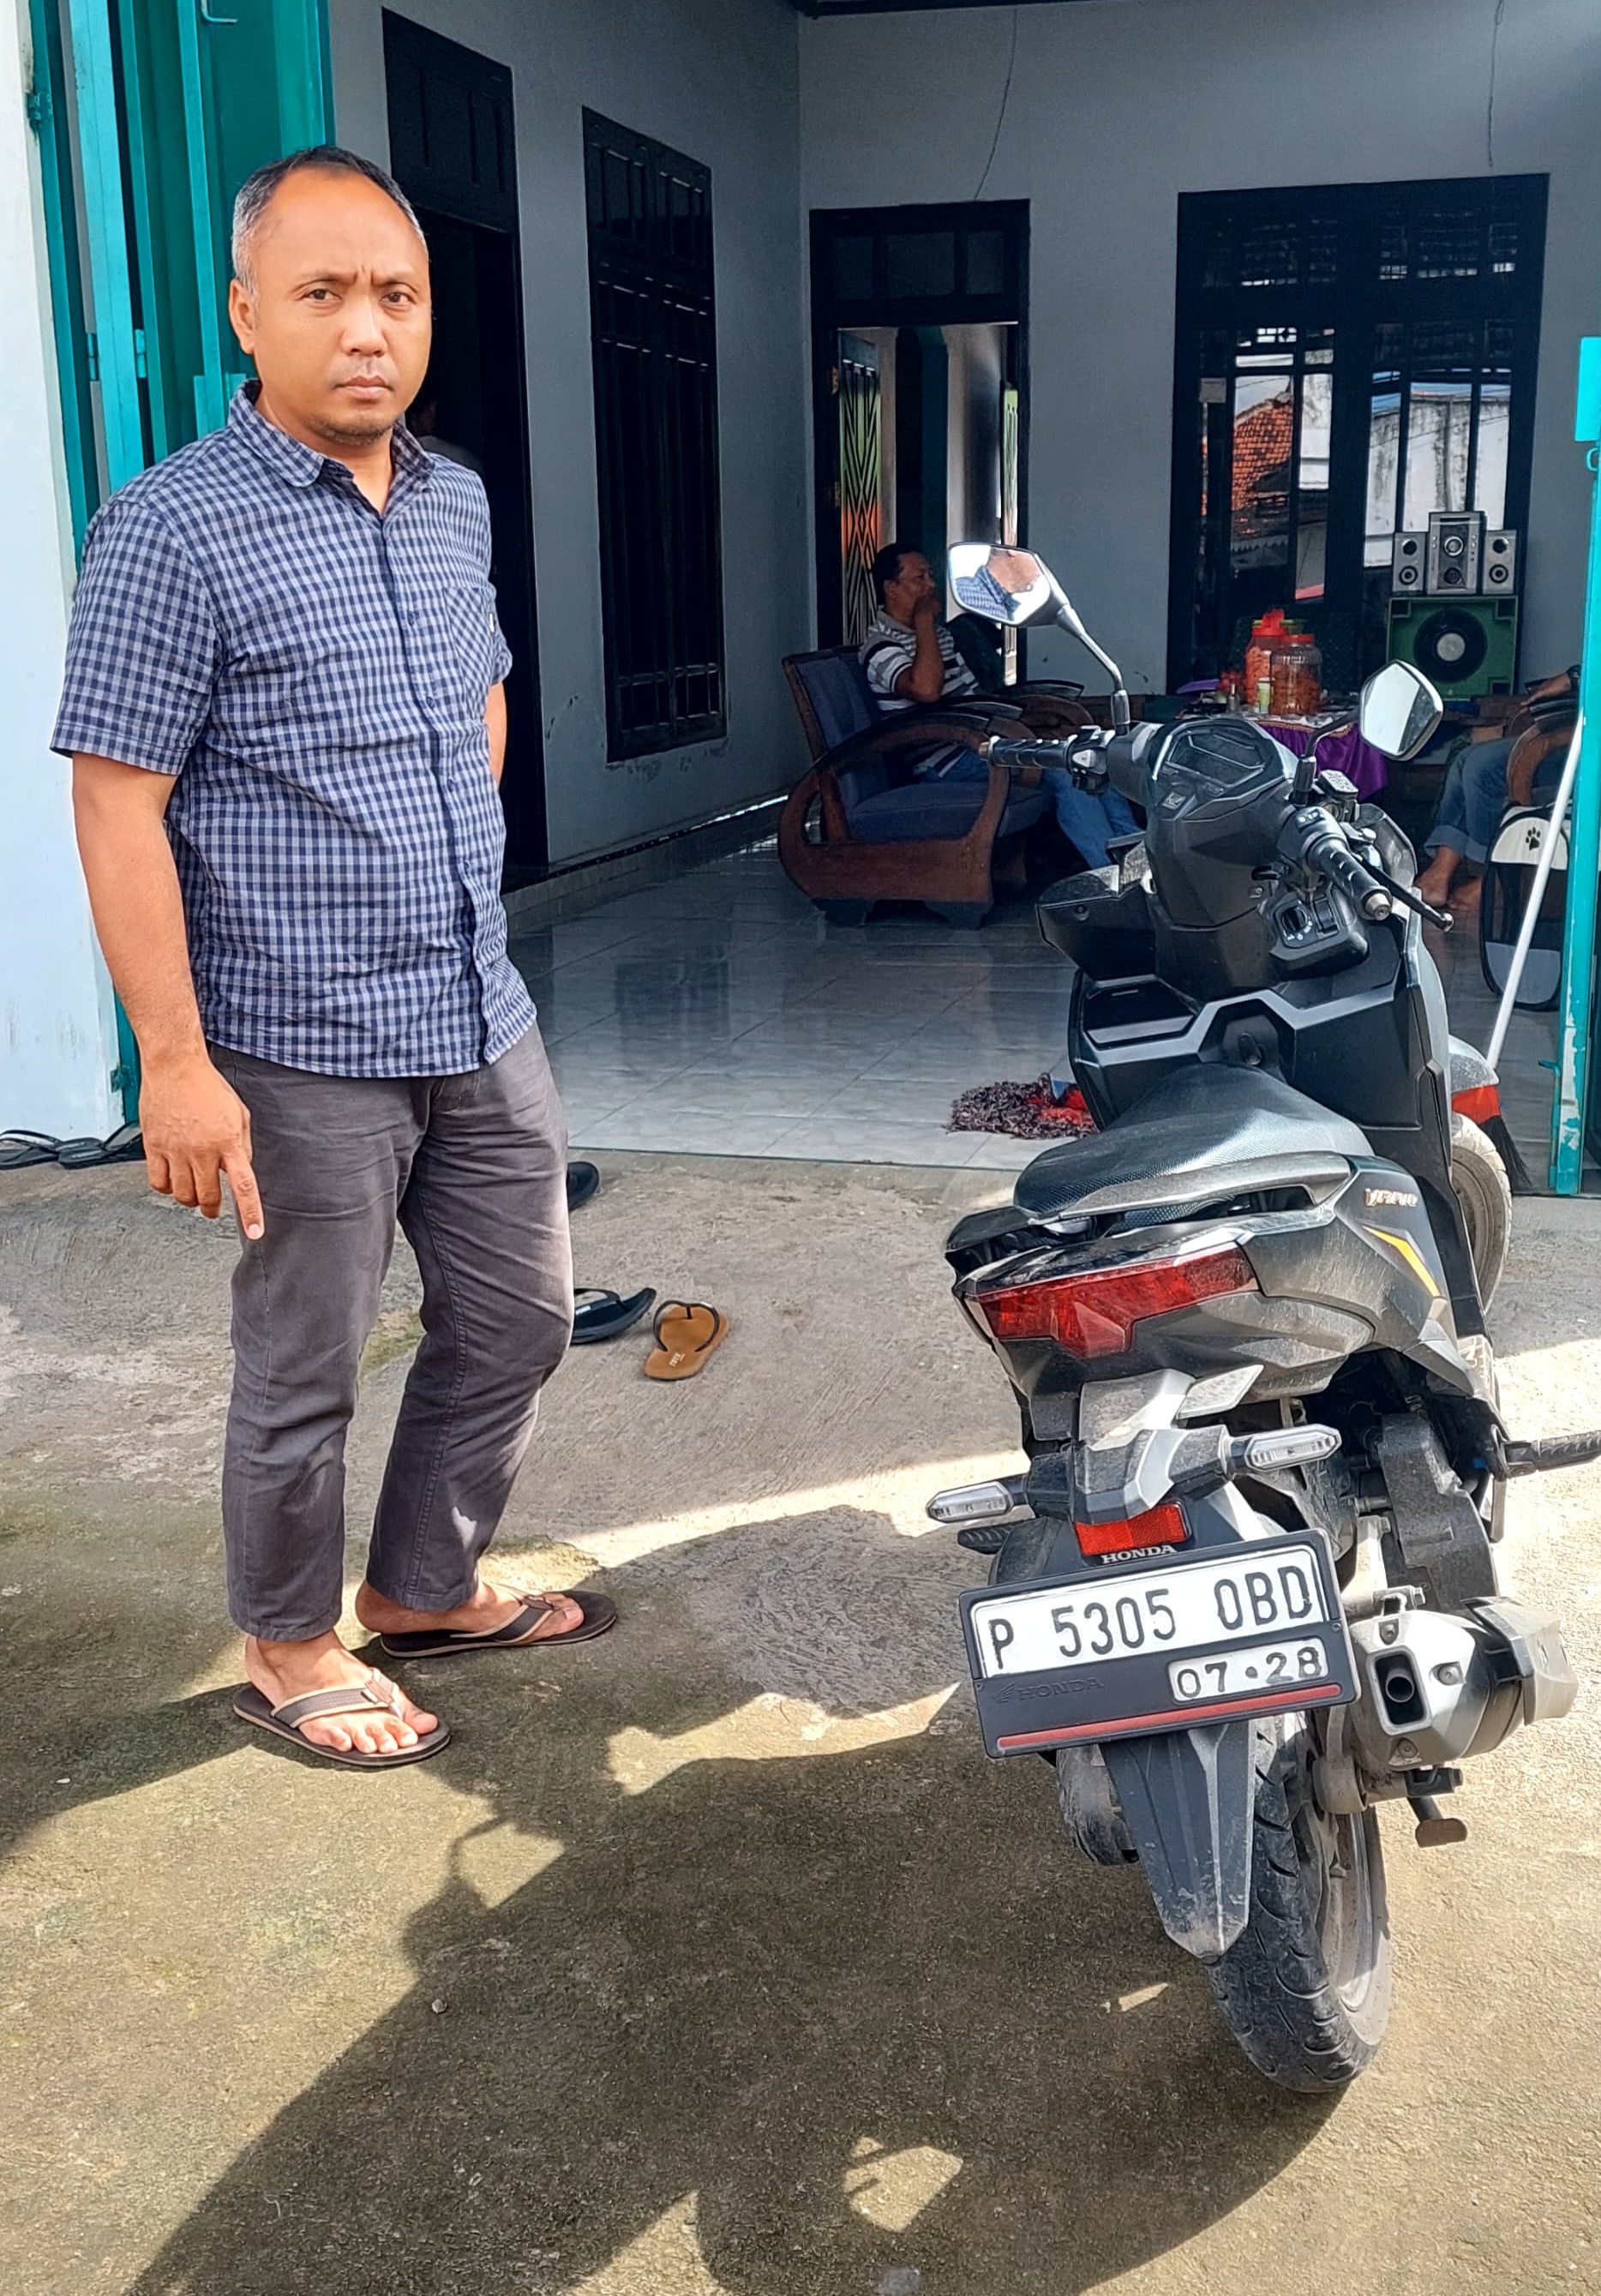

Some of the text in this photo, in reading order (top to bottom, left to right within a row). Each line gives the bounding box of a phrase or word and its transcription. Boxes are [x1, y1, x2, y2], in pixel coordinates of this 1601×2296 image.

[1100, 1544, 1178, 1564] HONDA
[988, 1565, 1314, 1670] P 5305 OBD
[1016, 1677, 1105, 1701] HONDA
